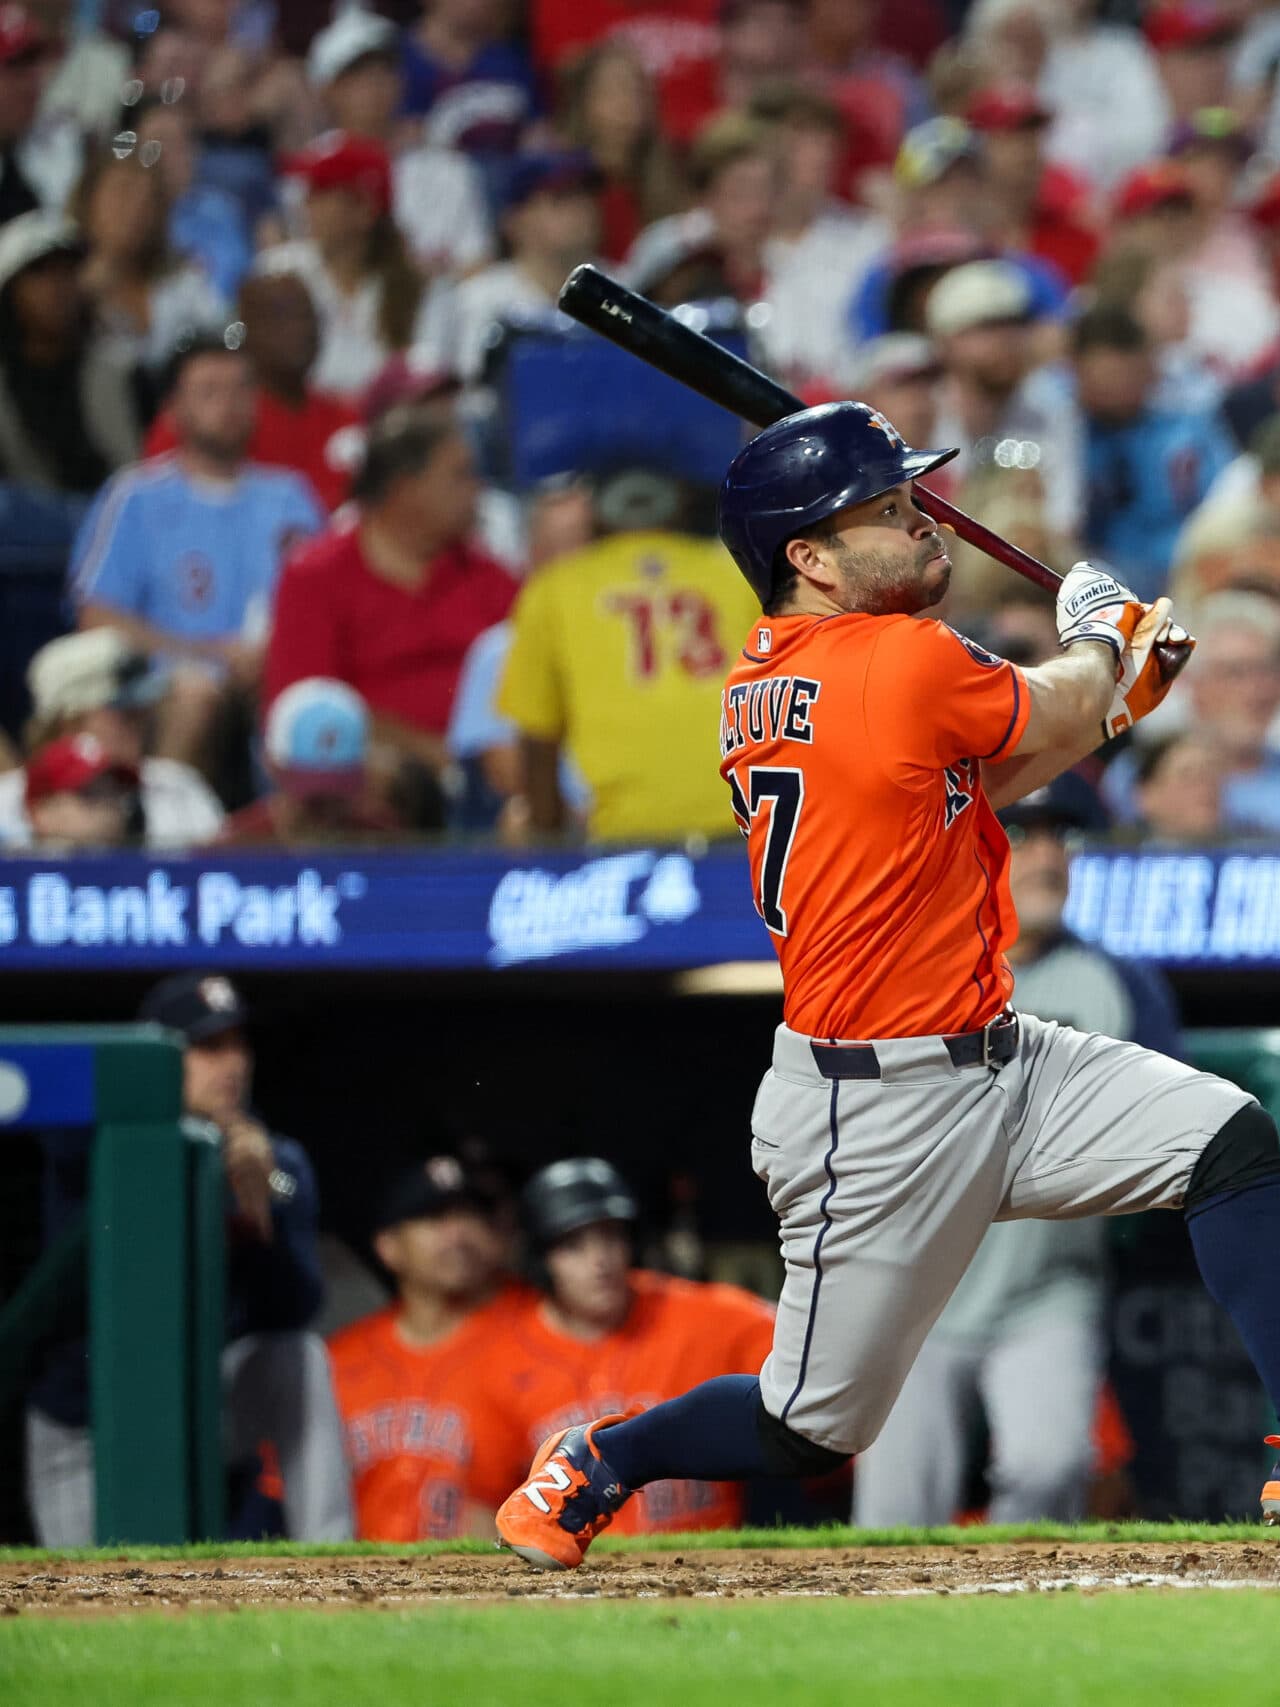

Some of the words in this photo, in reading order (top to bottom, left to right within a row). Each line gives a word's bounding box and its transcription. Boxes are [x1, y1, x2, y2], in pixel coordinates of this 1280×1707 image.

[719, 675, 821, 760] LTUVE
[727, 766, 804, 938] 7
[28, 869, 190, 945] Bank
[197, 868, 342, 945] Park
